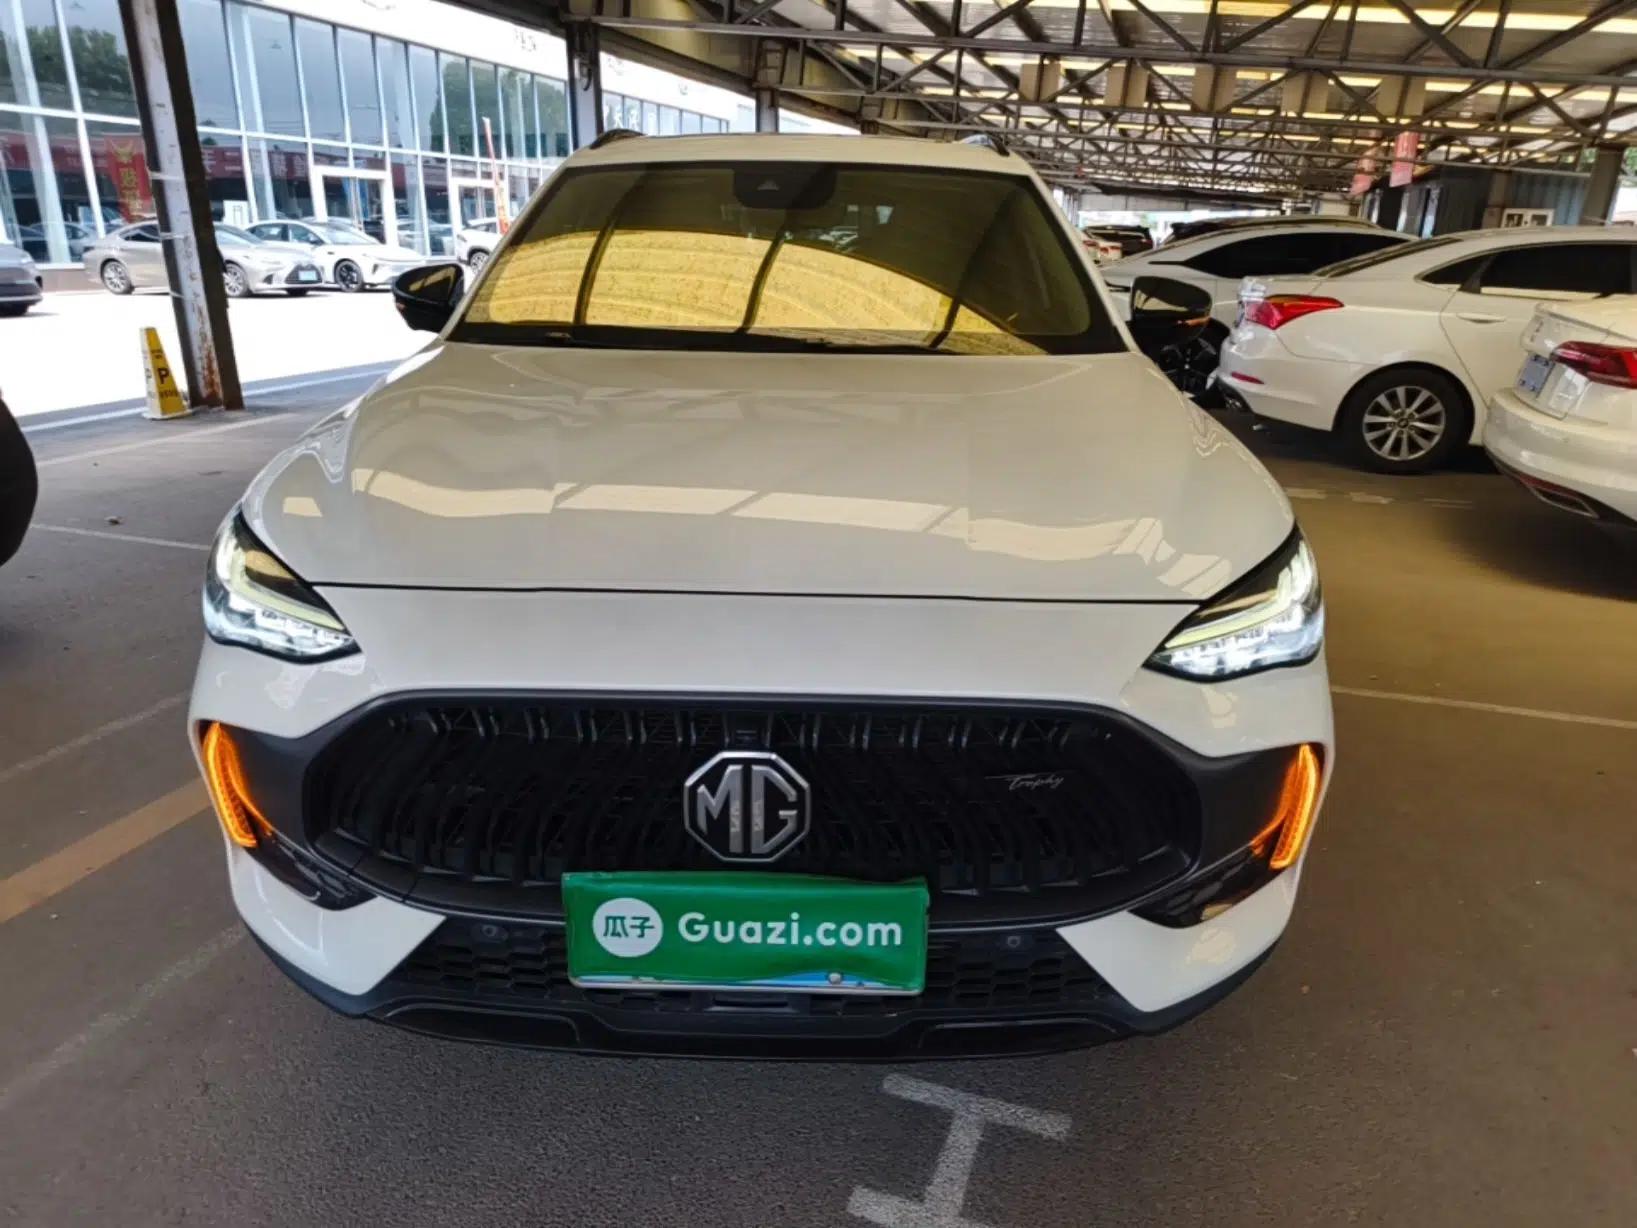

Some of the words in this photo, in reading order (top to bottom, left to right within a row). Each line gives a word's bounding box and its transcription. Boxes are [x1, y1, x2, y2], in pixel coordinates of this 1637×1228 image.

[157, 367, 170, 385] P
[697, 764, 798, 854] MG
[603, 915, 655, 938] 瓜子
[678, 911, 902, 947] Guazi.com
